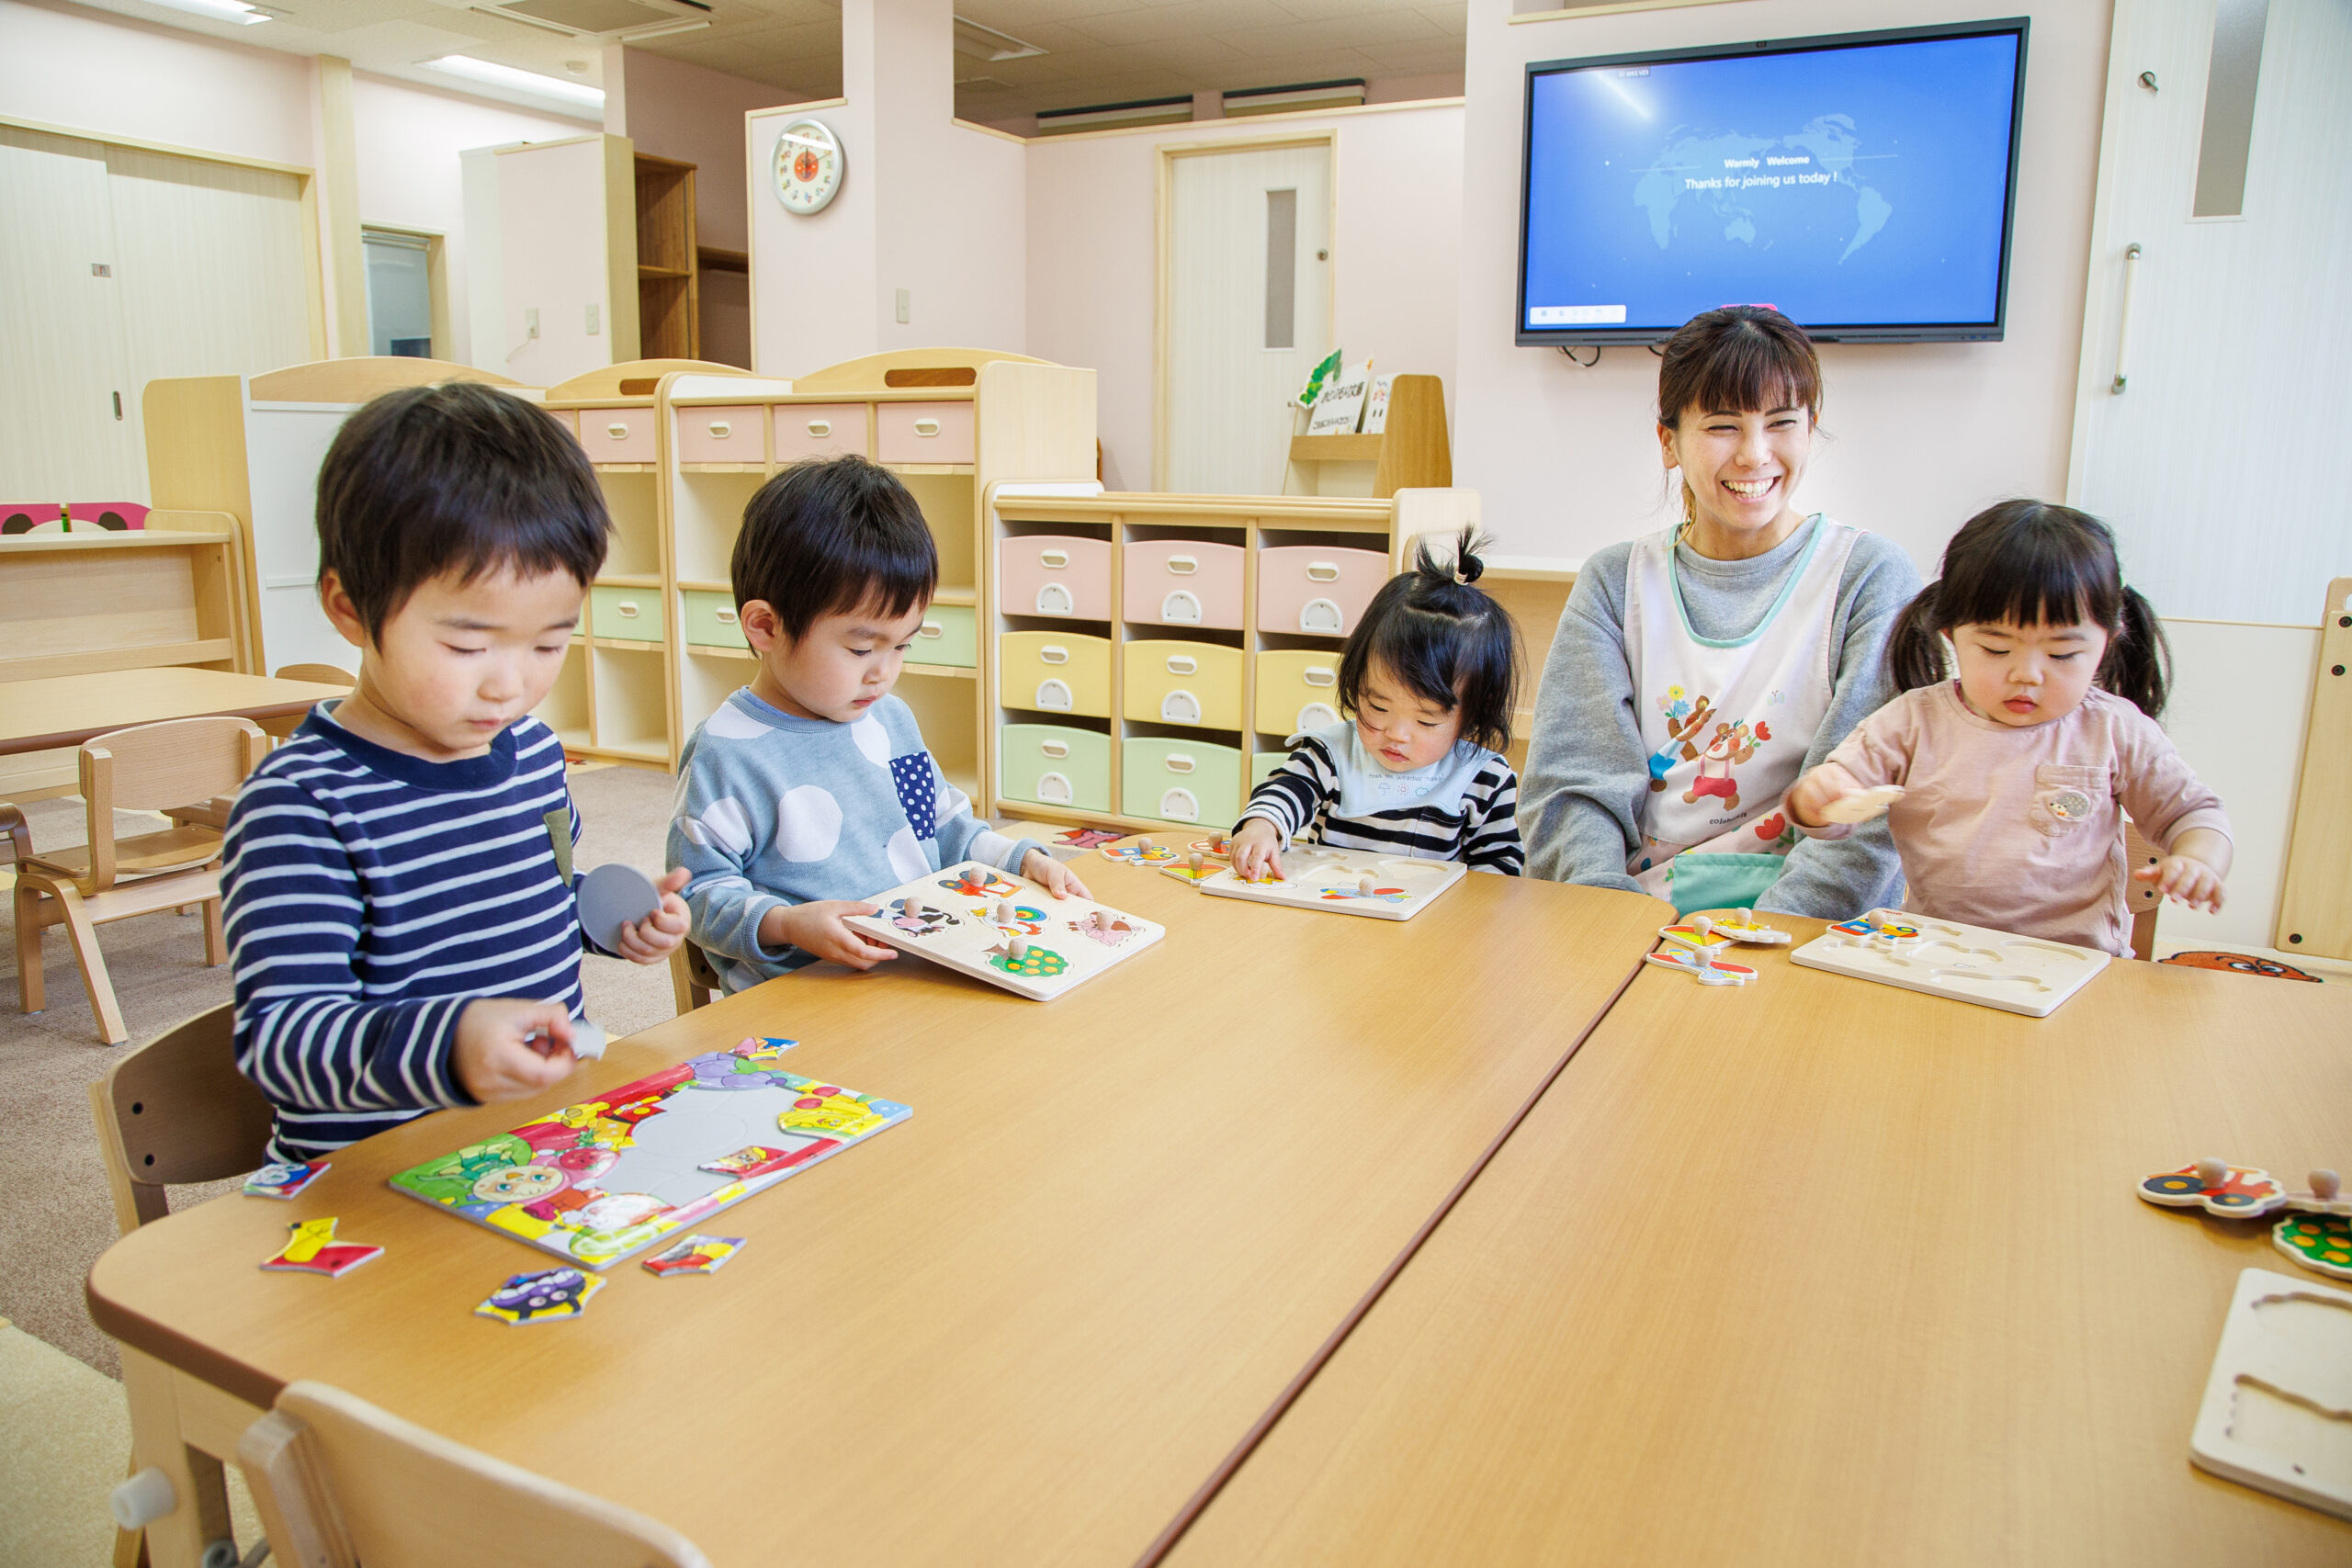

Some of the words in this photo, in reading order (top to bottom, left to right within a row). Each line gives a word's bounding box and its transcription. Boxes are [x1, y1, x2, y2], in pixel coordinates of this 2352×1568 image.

[1724, 157, 1759, 169] Warmly
[1766, 155, 1810, 166] Welcome
[1684, 177, 1722, 189] Thanks
[1724, 176, 1740, 187] for
[1741, 175, 1781, 188] joining
[1783, 175, 1796, 185] us
[1798, 171, 1830, 186] today
